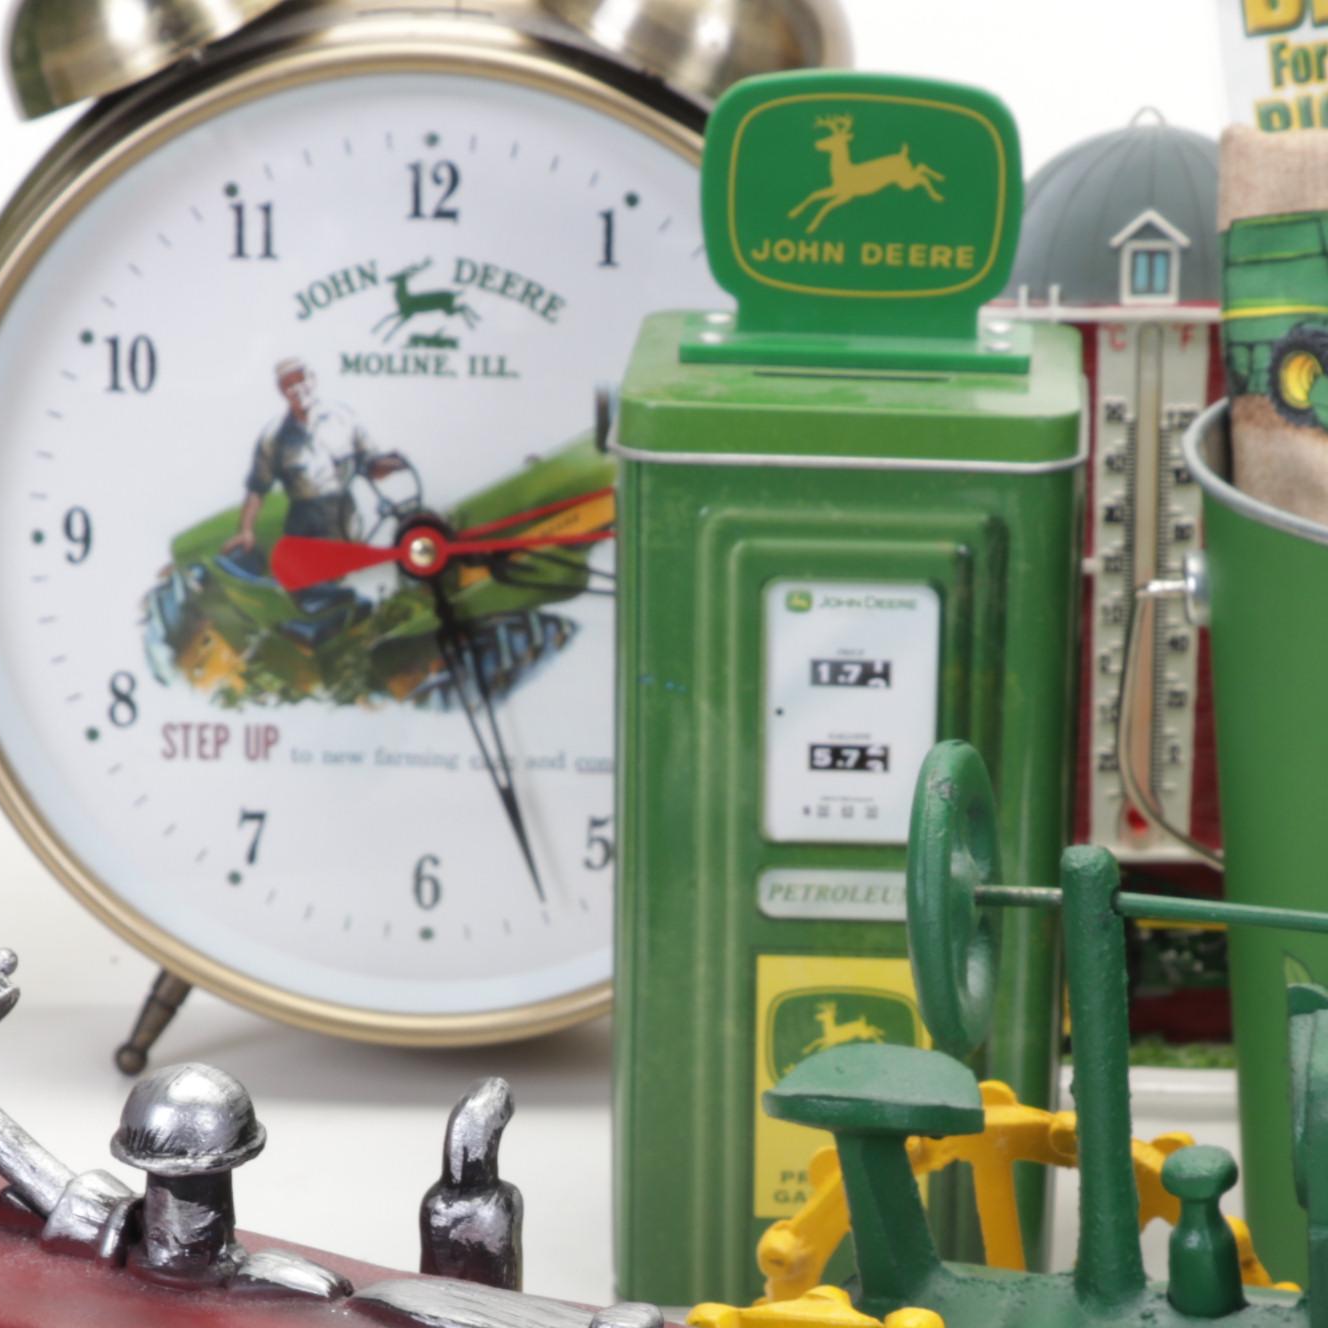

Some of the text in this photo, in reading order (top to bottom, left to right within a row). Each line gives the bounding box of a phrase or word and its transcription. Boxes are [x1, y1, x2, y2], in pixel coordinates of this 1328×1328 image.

[408, 160, 460, 222] 12
[230, 201, 278, 260] 11
[598, 209, 619, 267] 1
[751, 237, 976, 270] JOHN DEERE
[293, 259, 567, 324] JOHN DEERE
[103, 335, 158, 394] 10
[63, 506, 92, 565] 9
[106, 672, 138, 728] 8
[161, 723, 230, 761] STEP
[244, 726, 280, 762] UP
[238, 810, 267, 865] 7
[412, 855, 442, 910] 6
